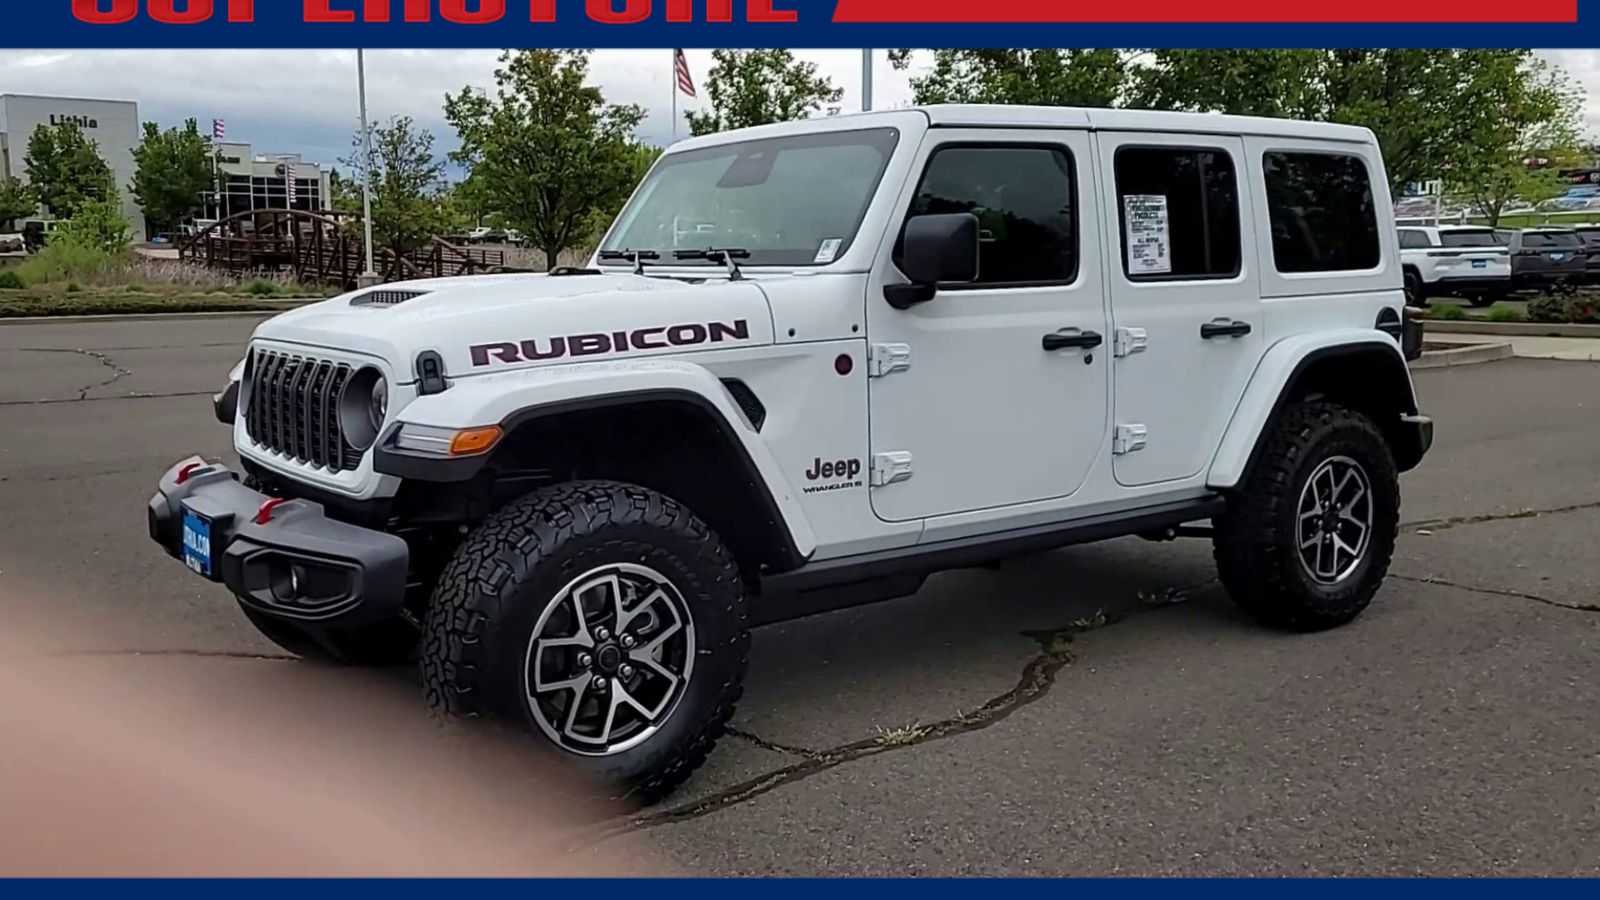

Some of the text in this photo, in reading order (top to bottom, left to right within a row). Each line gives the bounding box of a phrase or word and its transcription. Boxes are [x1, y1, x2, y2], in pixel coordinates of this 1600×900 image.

[469, 319, 750, 367] RUBICON
[805, 457, 861, 480] Jeep
[803, 482, 853, 493] WRANGLER
